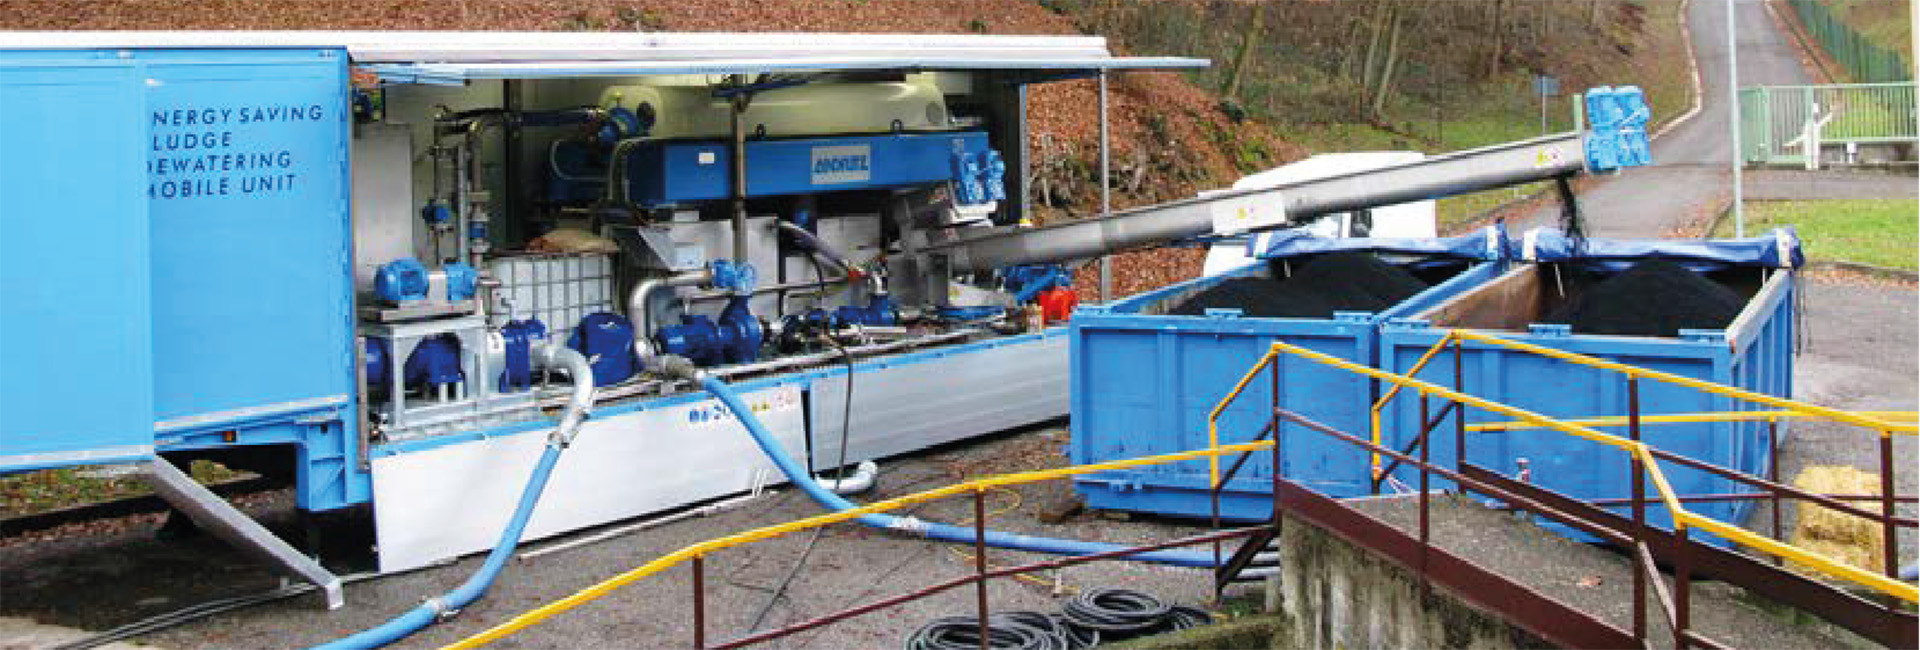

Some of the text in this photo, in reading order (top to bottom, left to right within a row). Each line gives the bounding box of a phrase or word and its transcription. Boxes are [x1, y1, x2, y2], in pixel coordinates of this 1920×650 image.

[153, 104, 323, 126] NERGY SAVING
[153, 131, 232, 151] LUDGE
[242, 174, 295, 193] UNIT
